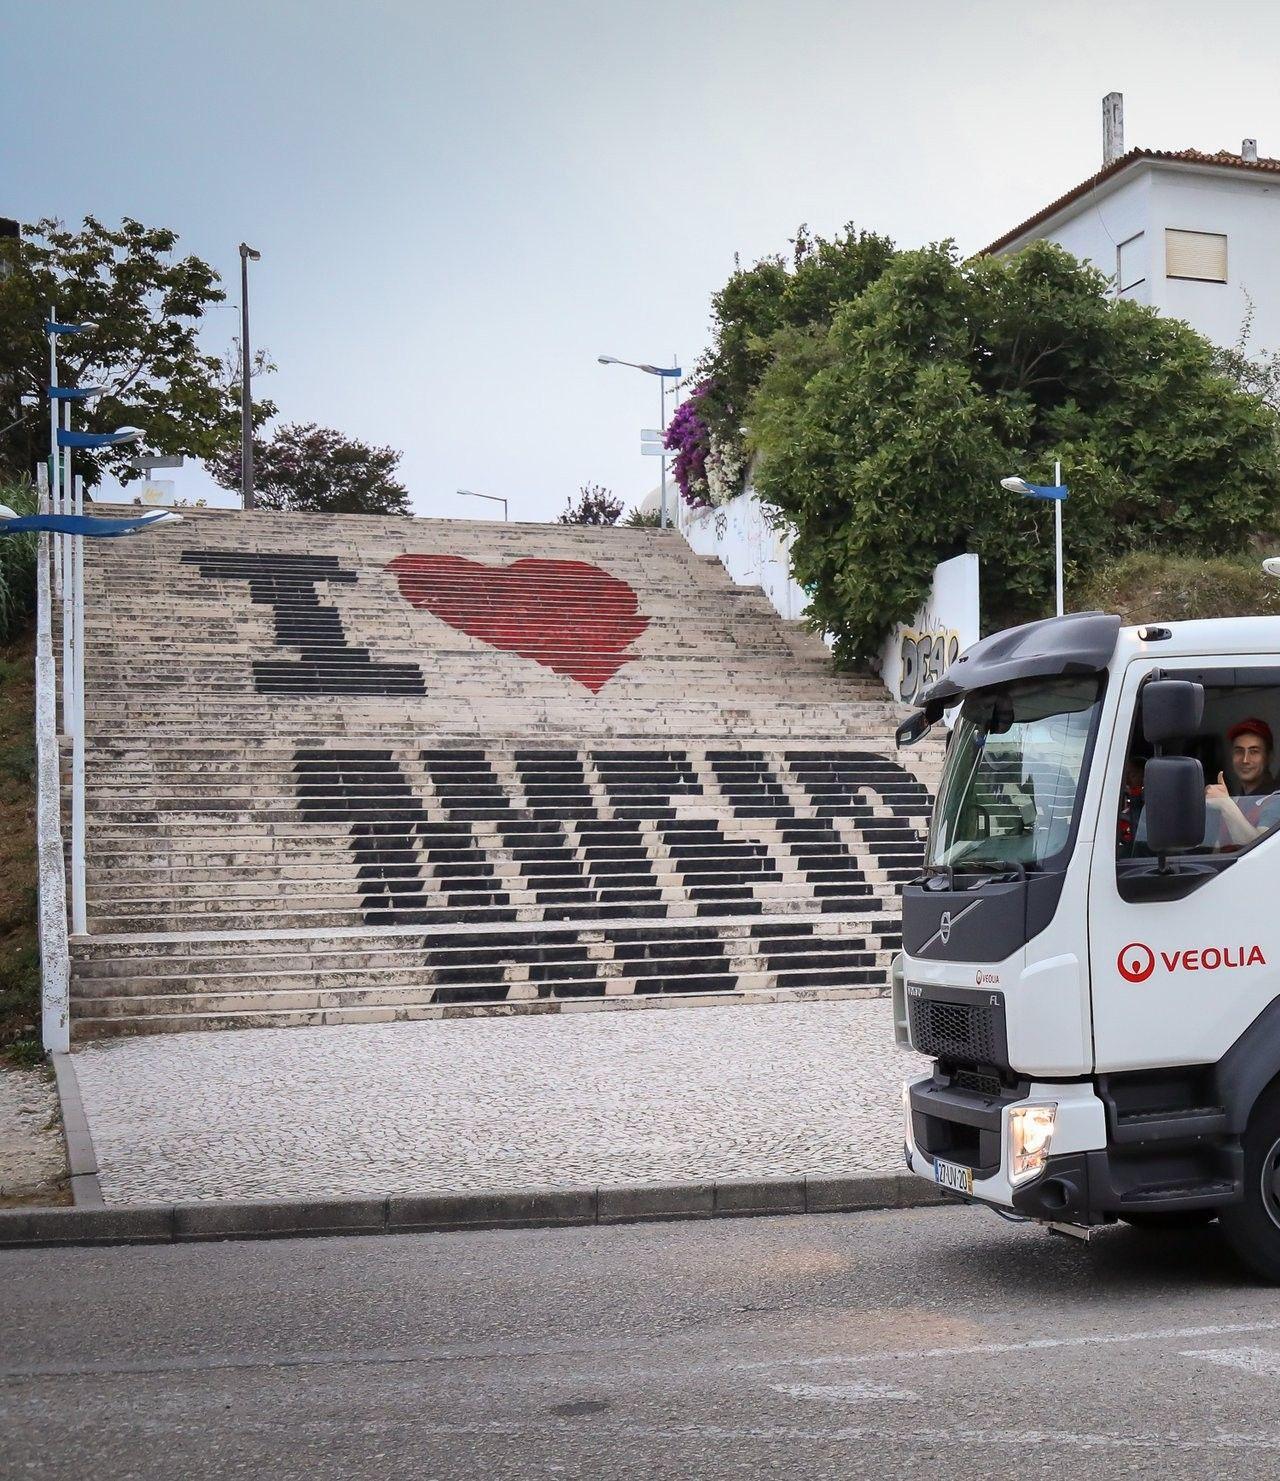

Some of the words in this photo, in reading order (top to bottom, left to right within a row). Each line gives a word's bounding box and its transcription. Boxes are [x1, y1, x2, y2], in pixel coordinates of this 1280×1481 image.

[179, 550, 429, 697] I
[1160, 945, 1267, 973] VEOLIA
[983, 973, 1001, 985] VEOLIA
